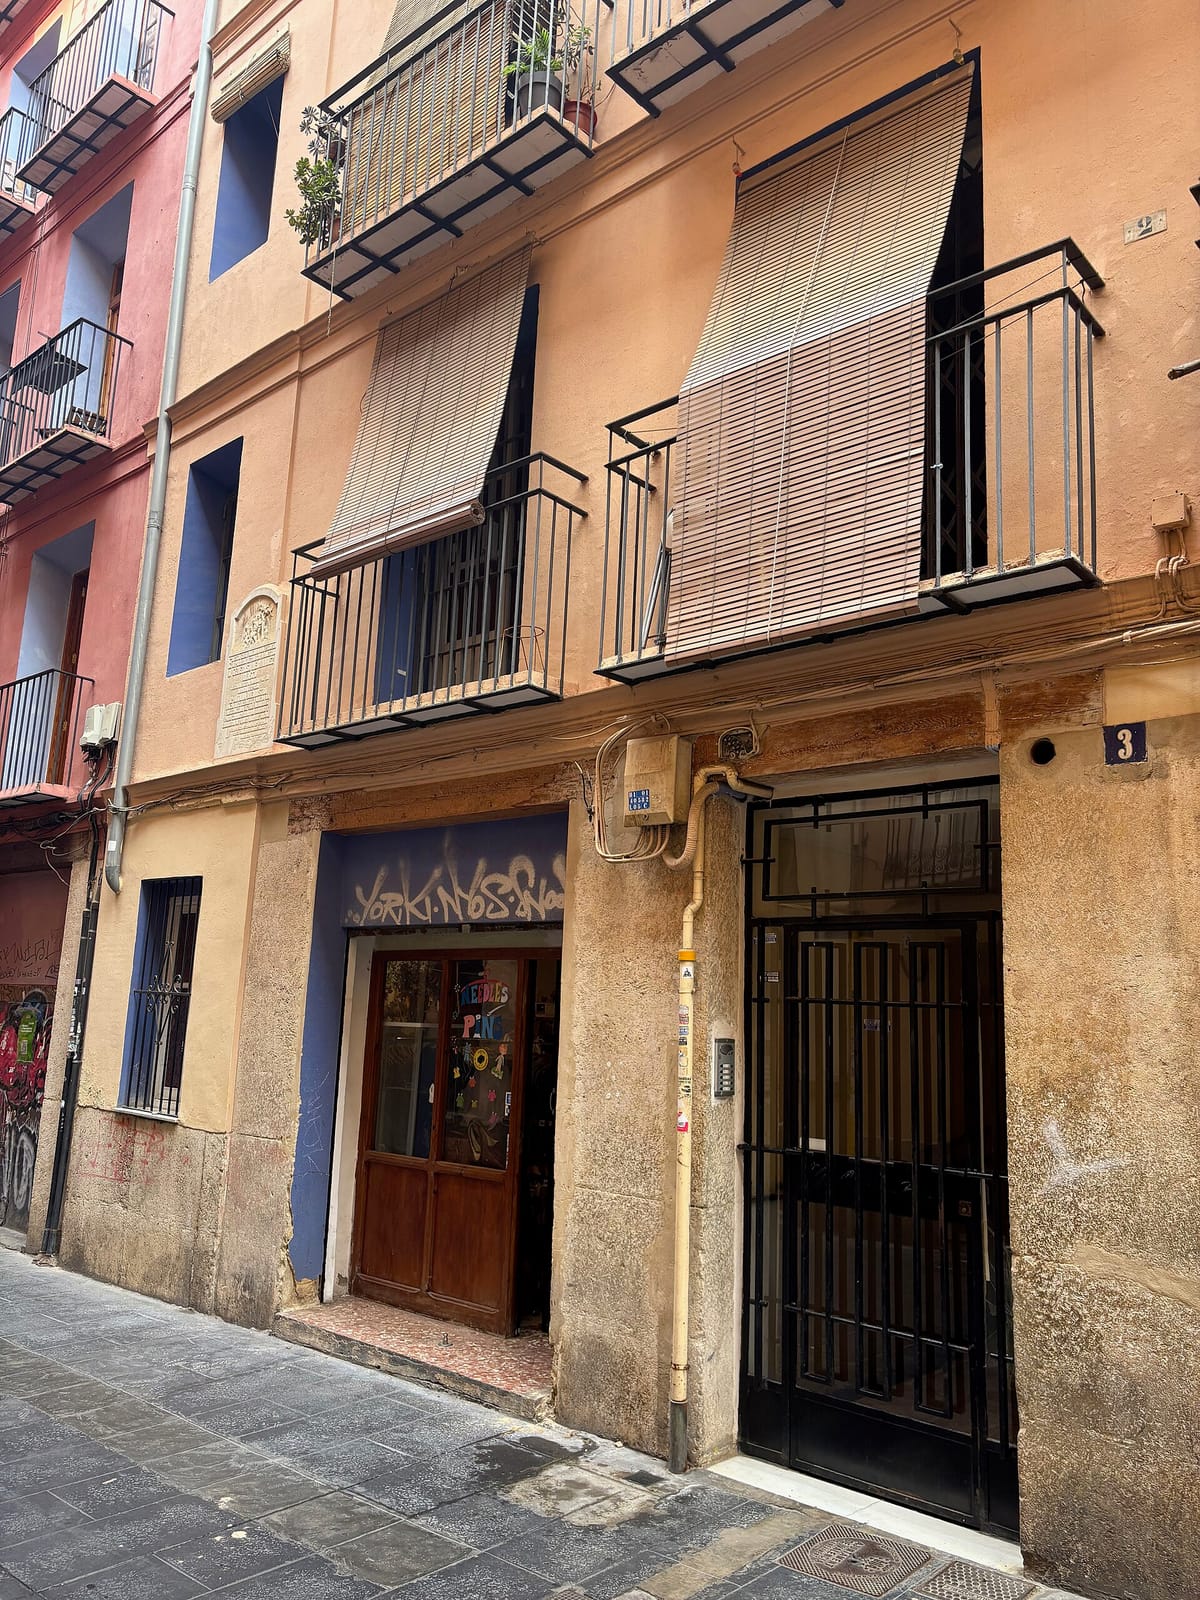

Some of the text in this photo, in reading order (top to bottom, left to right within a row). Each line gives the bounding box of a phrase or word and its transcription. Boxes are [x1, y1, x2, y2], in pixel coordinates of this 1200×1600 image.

[1137, 215, 1153, 237] 2
[1116, 728, 1134, 760] 3
[461, 982, 508, 1006] NEEDLES
